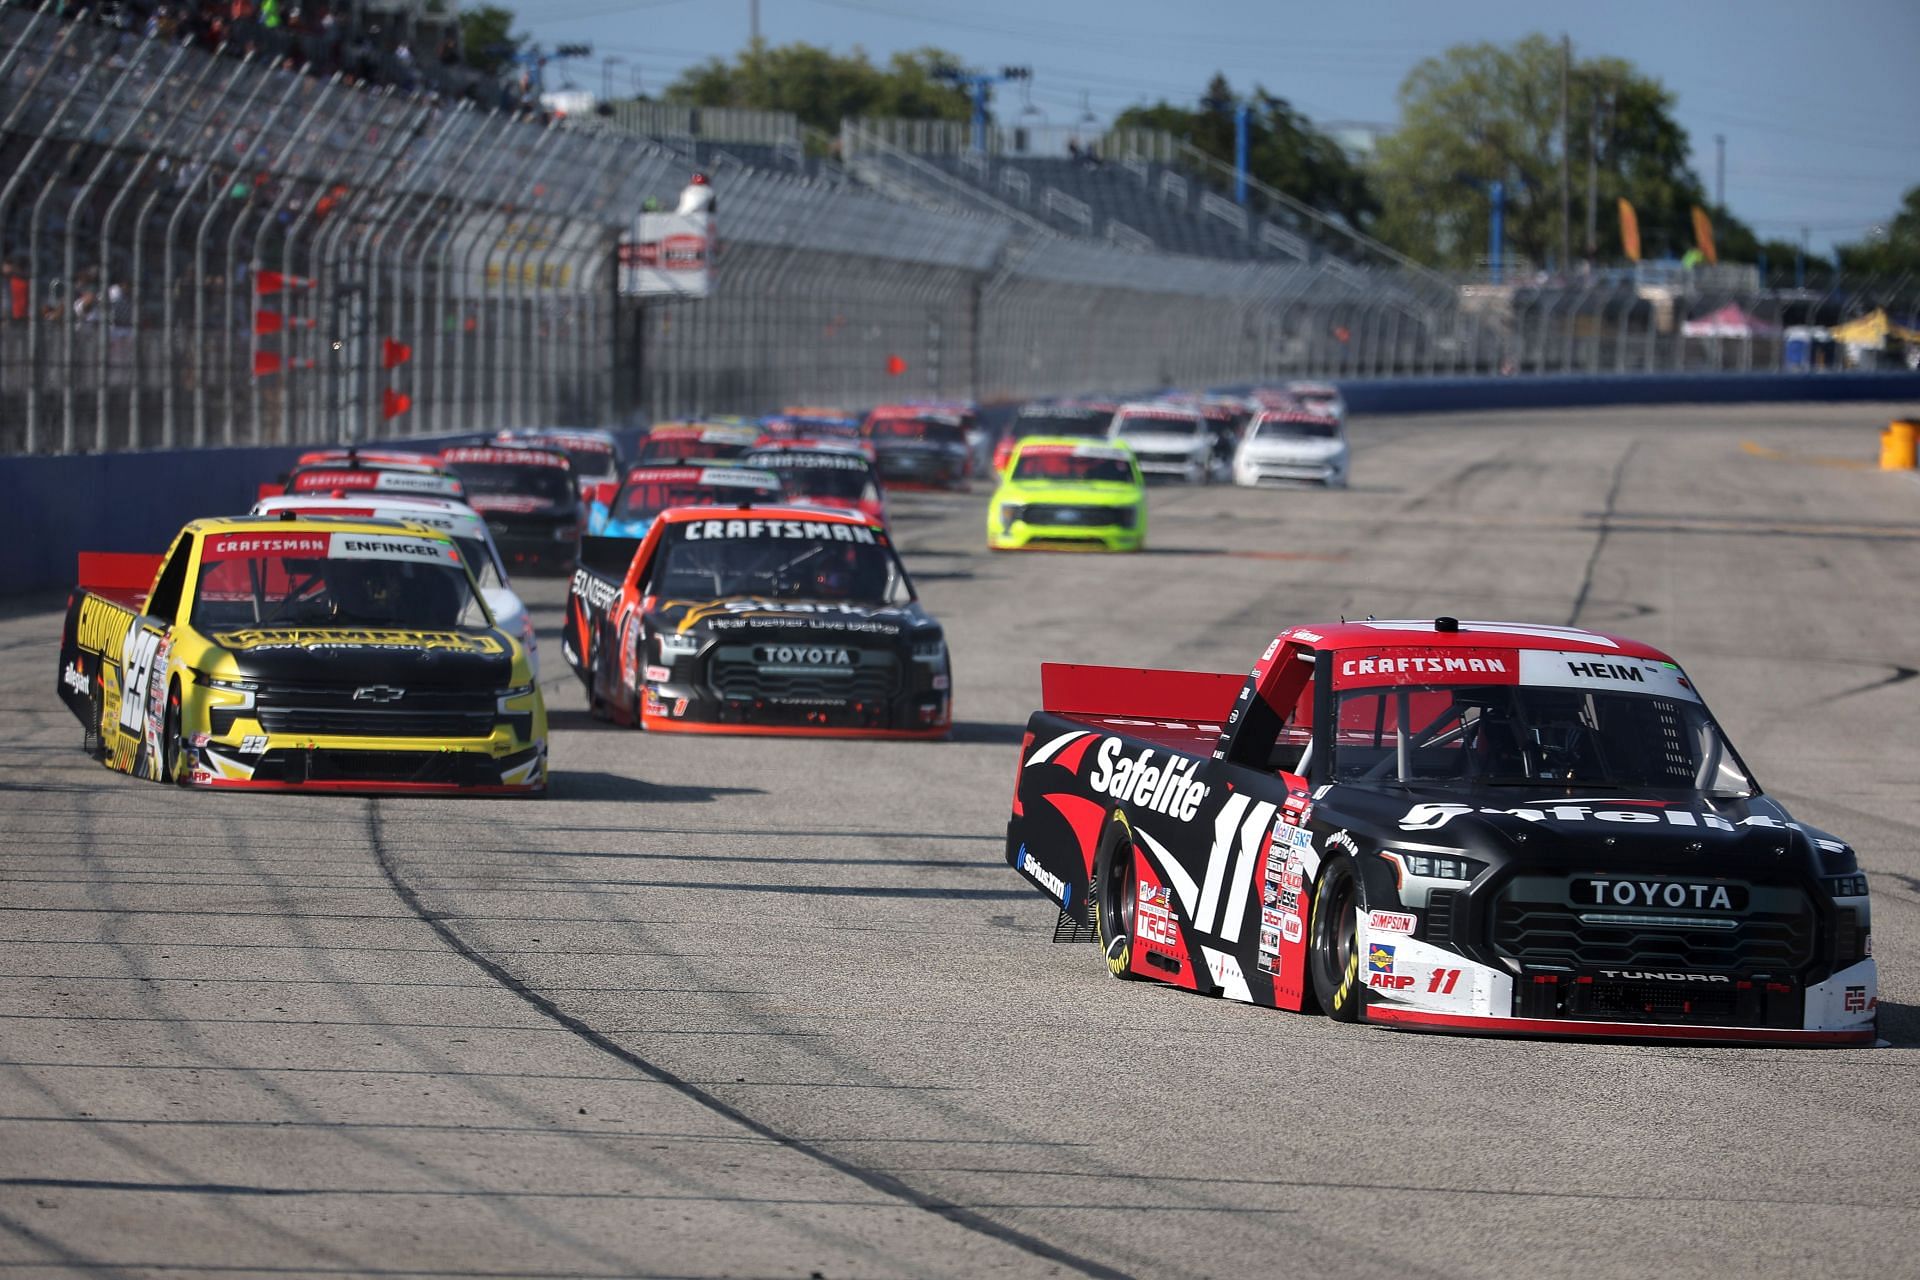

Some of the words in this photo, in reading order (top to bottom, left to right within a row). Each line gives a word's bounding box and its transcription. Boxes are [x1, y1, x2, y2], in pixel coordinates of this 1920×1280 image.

[685, 520, 876, 544] CRAFTSMAN
[216, 540, 324, 553] CRAFTSMAN
[345, 540, 440, 557] ENFINGER
[764, 647, 850, 665] TOYOTA
[1343, 657, 1506, 676] CRAFTSMAN
[1567, 661, 1645, 682] HEIM
[119, 630, 161, 735] 23
[239, 735, 269, 754] 23
[1090, 737, 1206, 823] Safelite
[1293, 830, 1312, 849] SKF
[1325, 828, 1359, 857] GOODYEAR
[1194, 792, 1278, 943] 11
[1590, 880, 1732, 909] TOYOTA
[1139, 909, 1166, 943] TRD
[1370, 913, 1411, 931] SIMPSON
[1369, 974, 1416, 990] ARP
[1426, 967, 1462, 995] 11
[1600, 970, 1730, 983] TUNDRA
